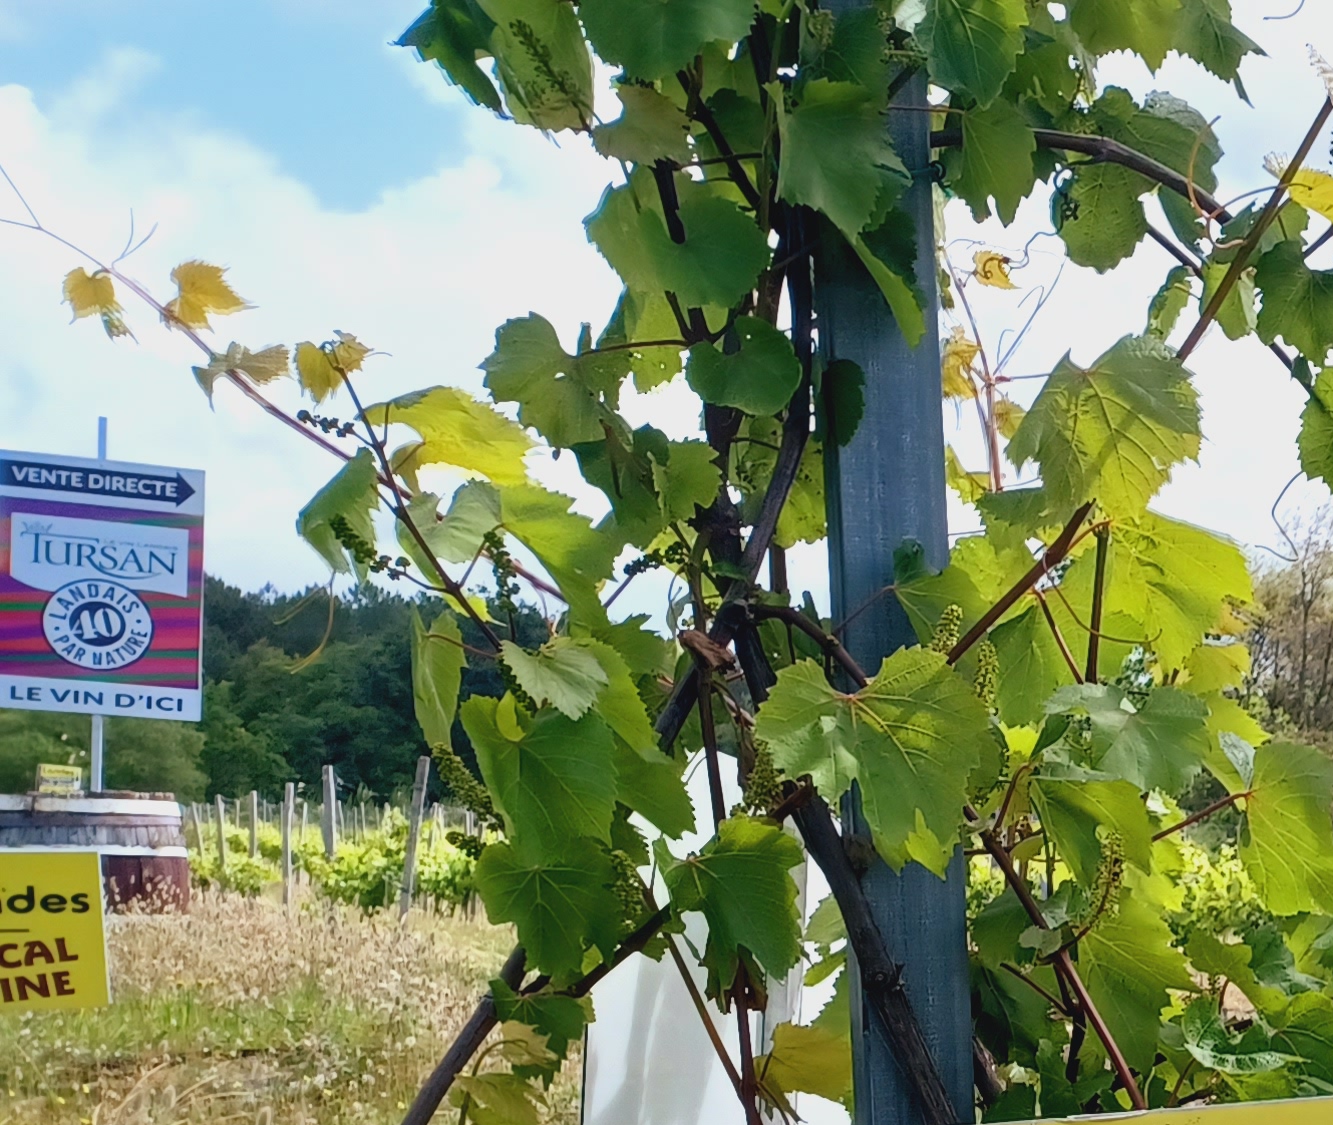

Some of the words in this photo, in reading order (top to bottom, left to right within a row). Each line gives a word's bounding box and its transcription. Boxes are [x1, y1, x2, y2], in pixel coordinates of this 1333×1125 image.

[11, 465, 83, 487] VENTE
[88, 473, 179, 498] DIRECTE
[20, 531, 177, 580] TURSAN
[49, 584, 140, 621] LANDAIS
[70, 607, 123, 640] 40
[53, 634, 87, 662] PAR
[92, 628, 148, 666] NATURE
[10, 685, 42, 702] LE
[50, 688, 104, 706] VIN
[115, 693, 183, 712] D'ICI
